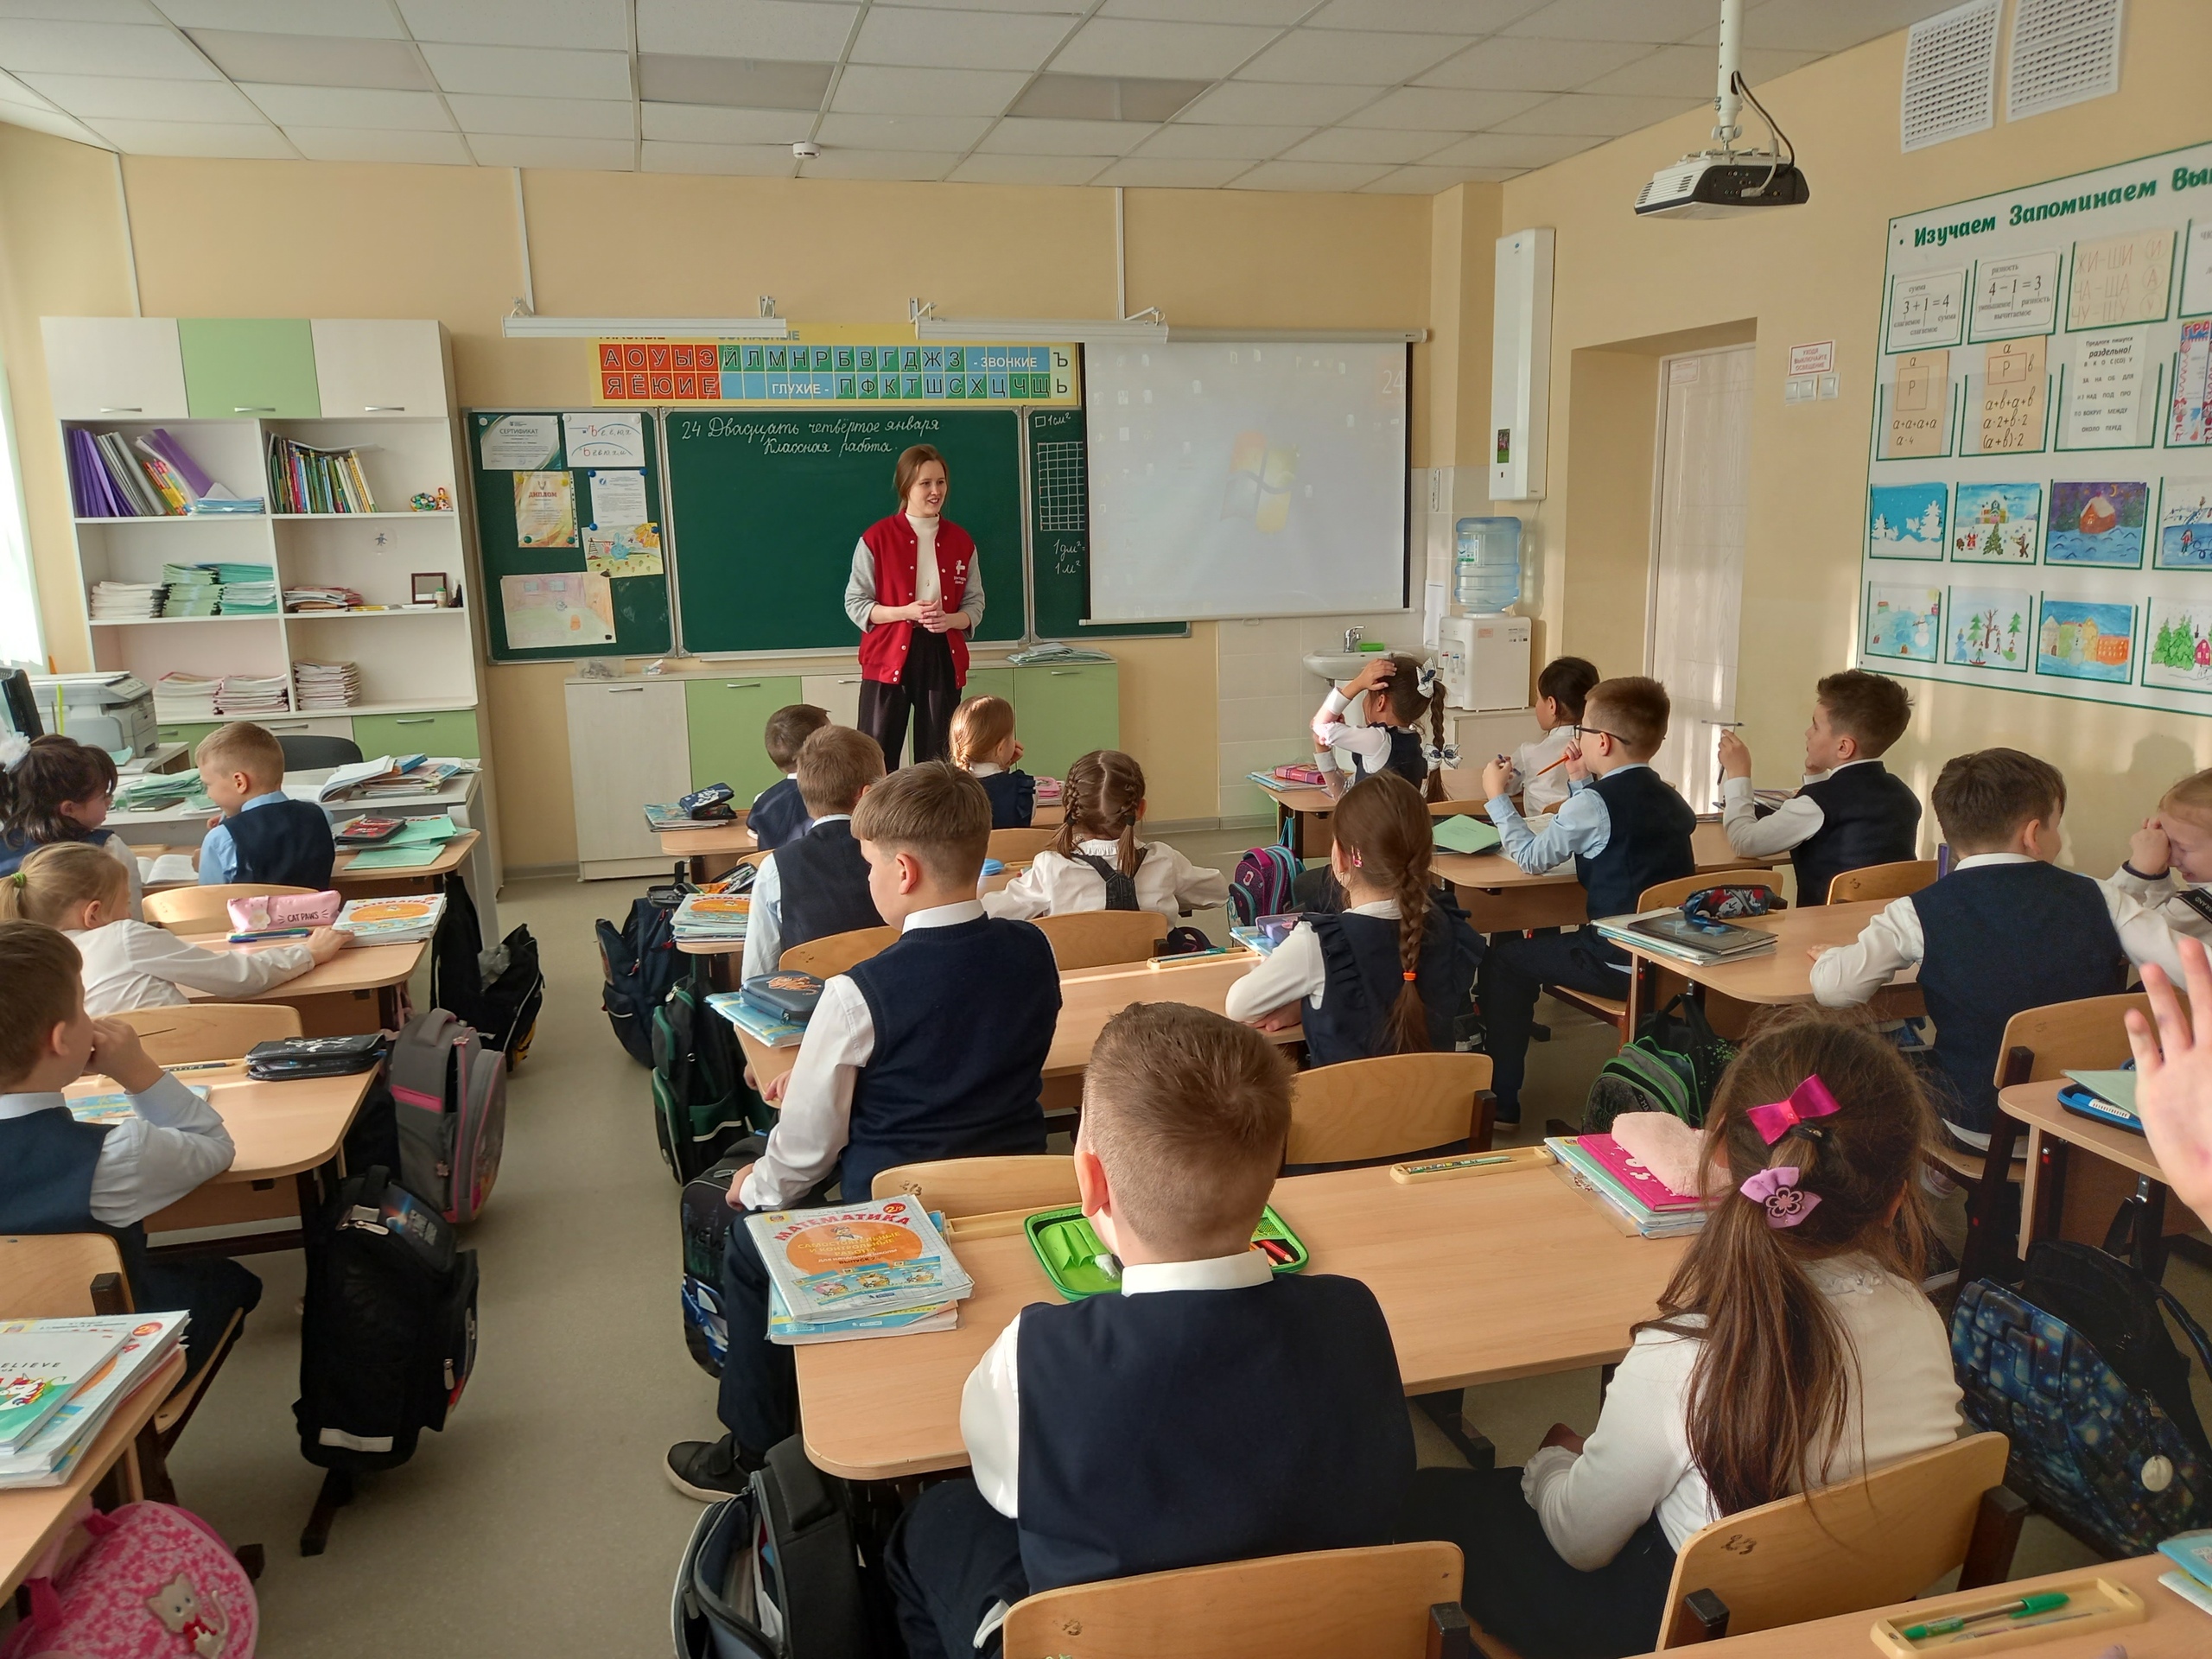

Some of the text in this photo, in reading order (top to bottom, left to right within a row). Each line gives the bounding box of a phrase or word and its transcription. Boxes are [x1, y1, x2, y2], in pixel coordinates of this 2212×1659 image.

[1914, 216, 1996, 247] Изучаем
[2009, 179, 2157, 226] Запоминаем
[605, 349, 620, 366] А
[628, 349, 644, 366] О
[652, 349, 666, 366] У
[675, 349, 693, 366] Ы
[700, 349, 714, 366] Э
[724, 346, 738, 367] Й
[747, 350, 760, 366] Л
[769, 350, 785, 366] М
[792, 350, 806, 366] Н
[816, 350, 828, 366] Р
[838, 351, 850, 366] Б
[861, 351, 873, 367] В
[884, 351, 894, 367] Г
[904, 351, 918, 370] Д
[923, 351, 942, 367] Ж
[949, 351, 961, 367] З
[981, 357, 1037, 368] ЗВОНКИЕ
[1053, 352, 1068, 368] Ъ
[2088, 345, 2132, 359] раздельно!
[607, 378, 622, 395] Я
[632, 374, 645, 395] Ё
[652, 378, 672, 395] Ю
[678, 378, 693, 395] И
[702, 378, 716, 395] Е
[772, 384, 821, 395] ГЛУХИЕ
[840, 378, 853, 394] П
[861, 378, 875, 394] Ф
[885, 378, 896, 394] К
[906, 378, 918, 394] Т
[926, 378, 943, 394] Ш
[949, 378, 962, 394] С
[970, 378, 984, 394] Х
[993, 378, 1006, 397] Ц
[1013, 378, 1026, 394] Ч
[1033, 378, 1050, 397] Щ
[1056, 378, 1068, 394] Ь
[1382, 370, 1404, 394] 24
[682, 416, 939, 443] 24 Двадцать четвёртое января
[763, 438, 831, 454] Классная
[287, 911, 319, 923] CAT PAWS
[773, 1213, 910, 1241] МАТЕМАТИКА
[798, 1230, 901, 1249] САМОСТОЯТЕЛЬНЫЕ
[818, 1238, 895, 1252] КОНТРОЛЬНЫЕ
[835, 1247, 876, 1256] РАБОТЫ
